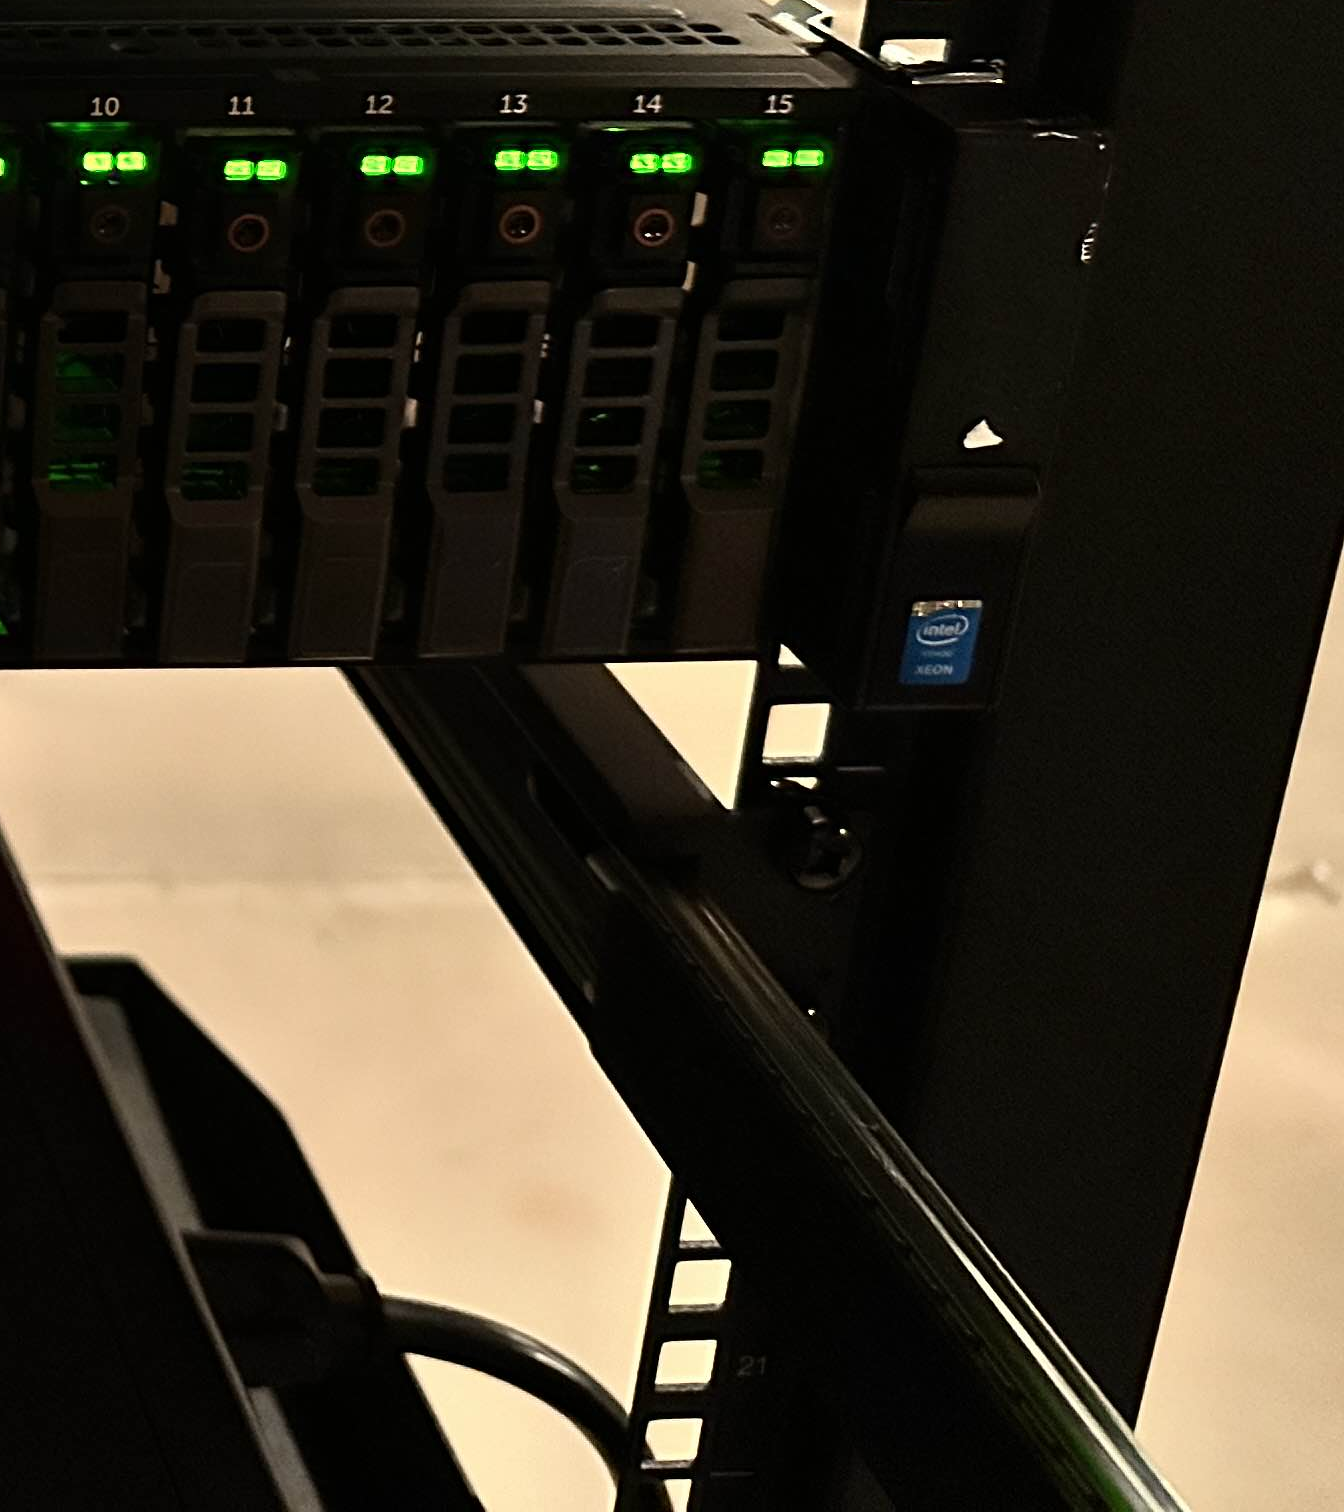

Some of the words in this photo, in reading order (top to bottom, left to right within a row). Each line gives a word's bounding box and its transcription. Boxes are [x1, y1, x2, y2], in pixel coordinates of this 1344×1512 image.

[91, 96, 120, 117] 10
[228, 96, 255, 116] 11
[365, 94, 393, 115] 12
[500, 94, 528, 114] 13
[633, 94, 662, 114] 14
[765, 94, 793, 114] 15
[914, 664, 954, 676] XEON
[736, 1355, 767, 1377] 21
